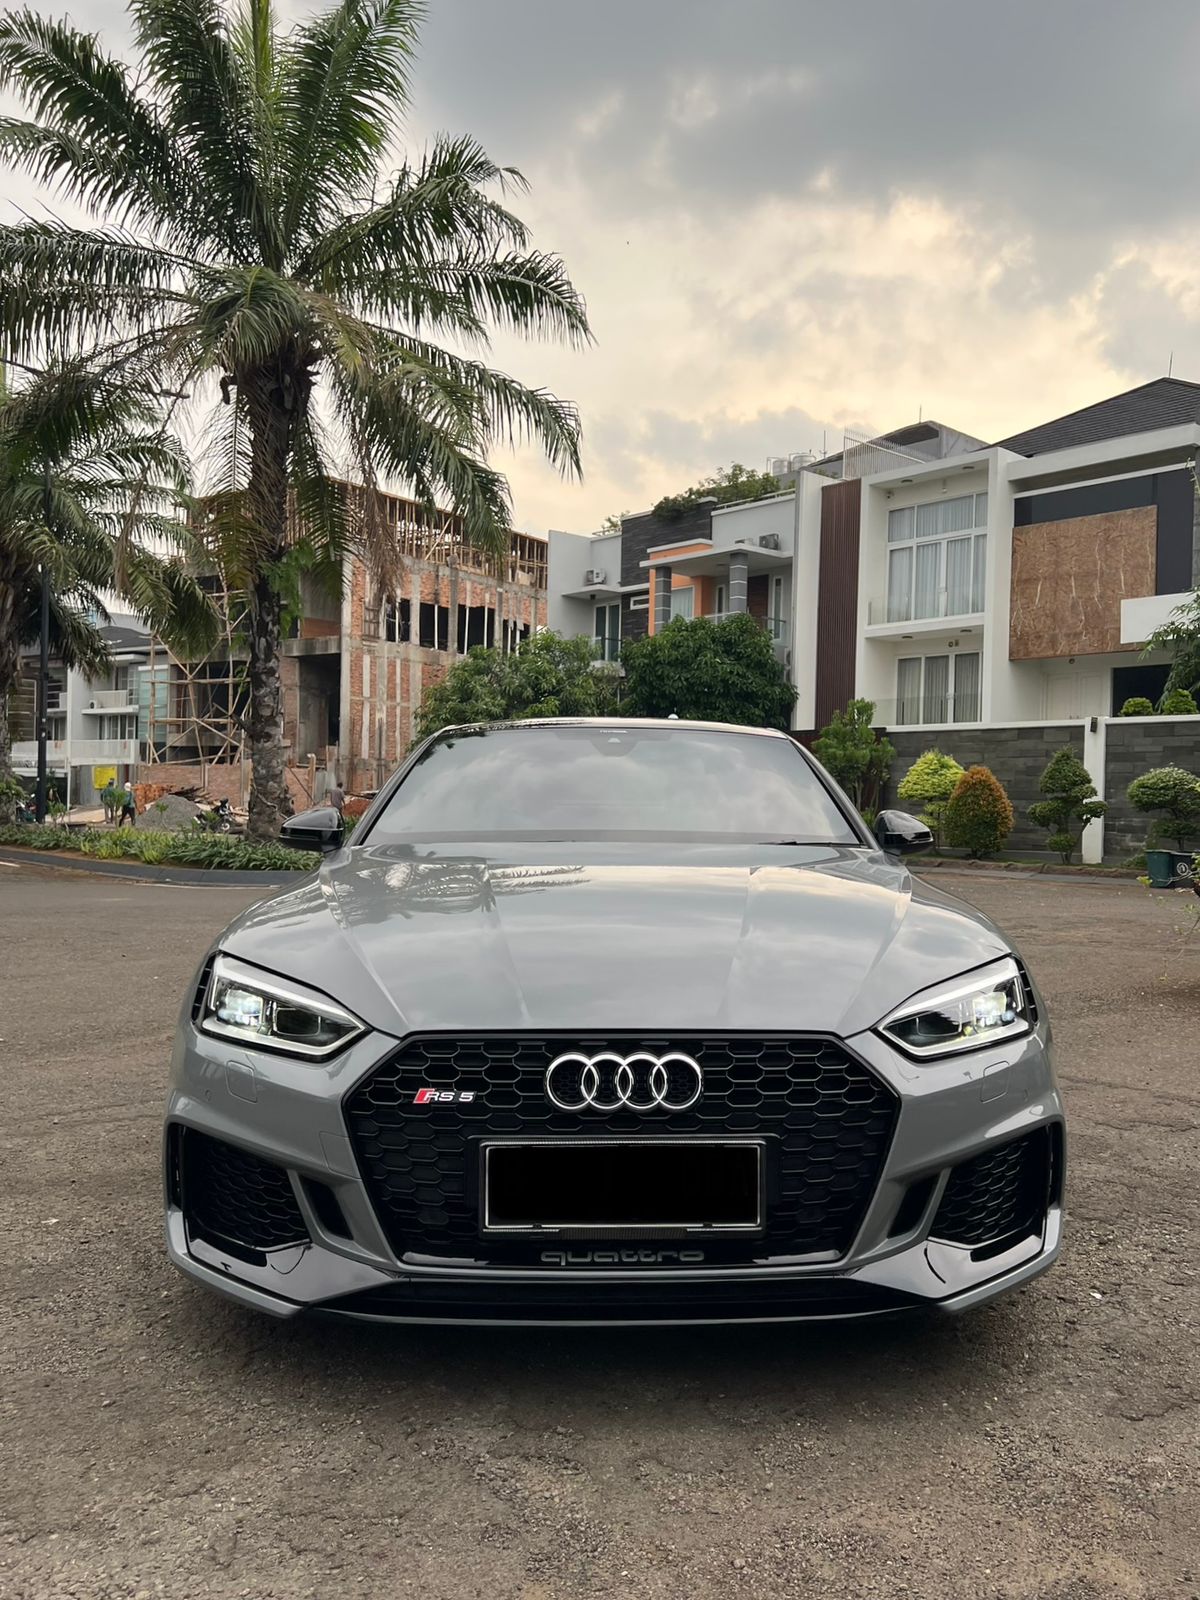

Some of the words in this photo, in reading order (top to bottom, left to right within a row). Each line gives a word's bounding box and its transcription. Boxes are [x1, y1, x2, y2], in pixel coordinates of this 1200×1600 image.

[422, 1091, 455, 1102] RS
[458, 1091, 475, 1102] 5
[540, 1250, 705, 1266] quattro
